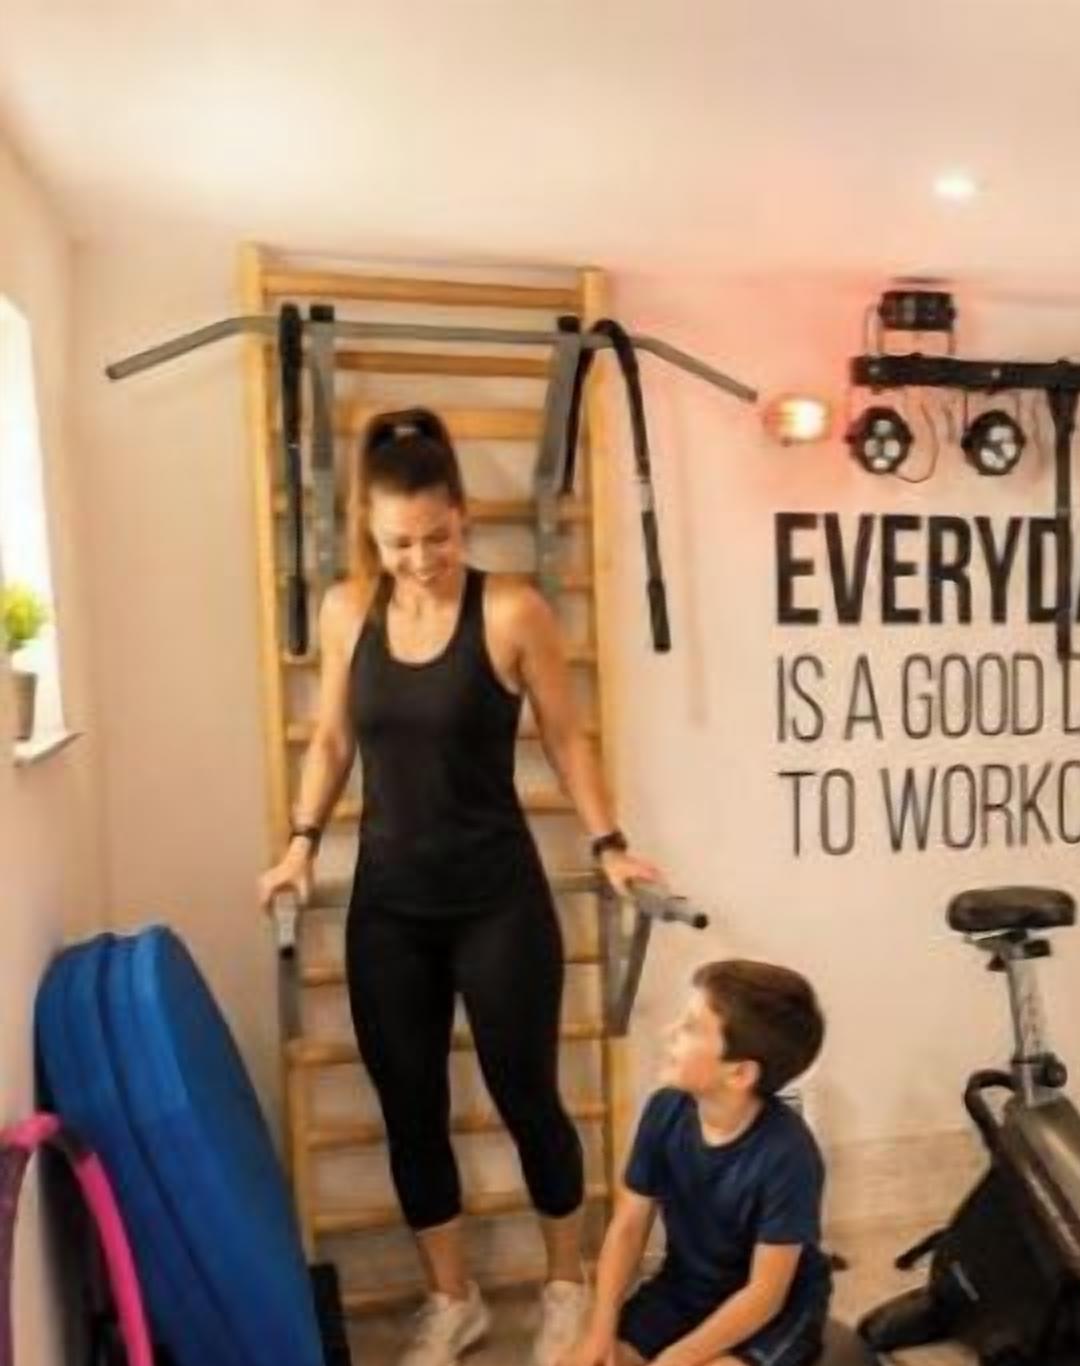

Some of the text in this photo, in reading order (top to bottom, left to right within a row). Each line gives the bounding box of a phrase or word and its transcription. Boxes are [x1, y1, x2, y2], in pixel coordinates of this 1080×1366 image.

[776, 654, 825, 743] IS
[843, 654, 884, 741] A
[901, 652, 1045, 740] GOOD
[775, 768, 856, 857] TO
